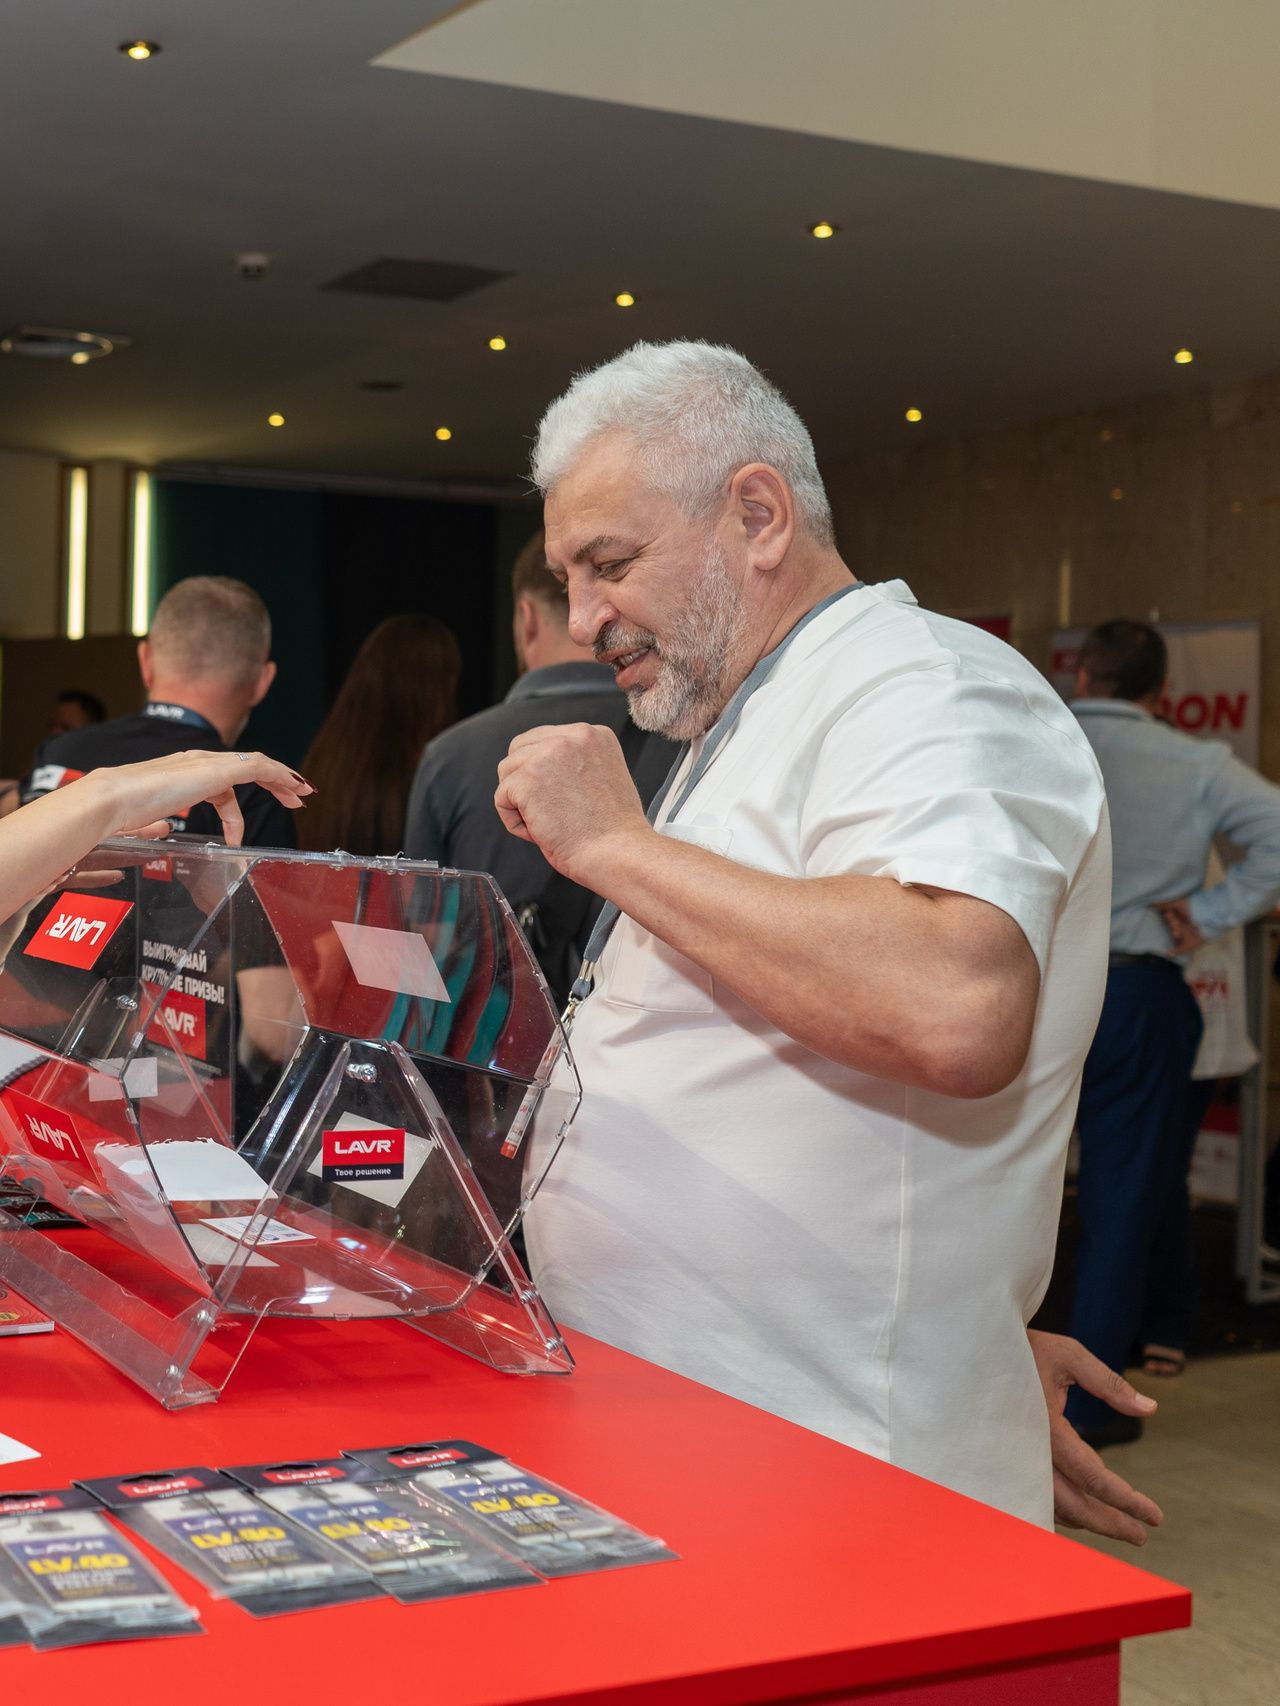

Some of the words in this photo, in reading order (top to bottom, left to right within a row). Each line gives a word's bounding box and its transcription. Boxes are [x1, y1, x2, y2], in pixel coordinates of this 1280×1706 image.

[146, 704, 185, 719] LAVR
[48, 914, 107, 945] LAVR
[184, 980, 225, 1005] ПРИЗЫ!
[25, 1113, 80, 1159] LAVR
[334, 1139, 392, 1154] LAVR
[355, 1168, 391, 1177] решение
